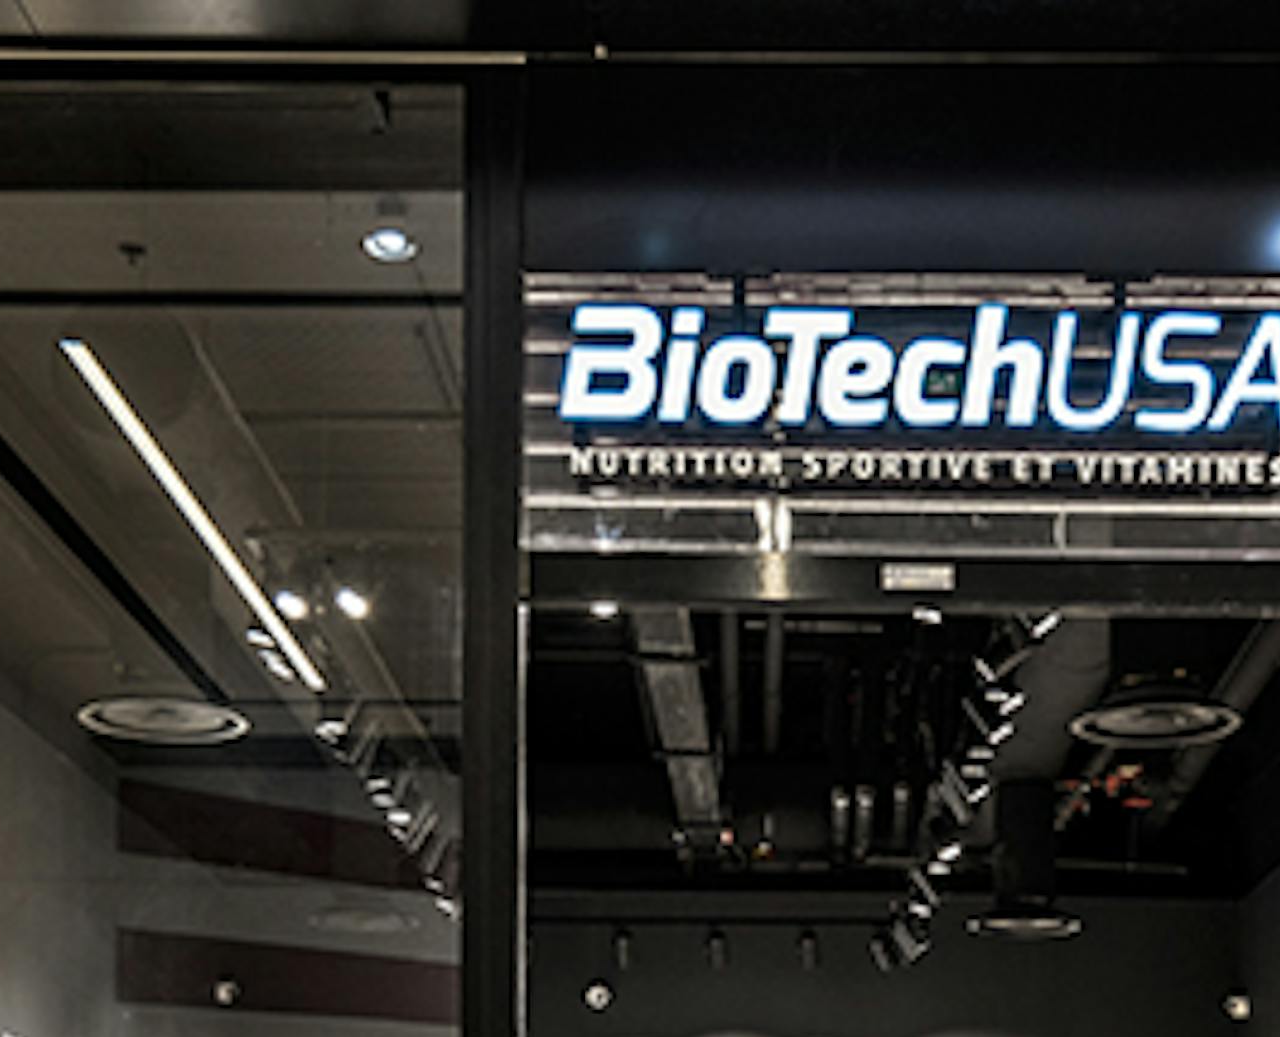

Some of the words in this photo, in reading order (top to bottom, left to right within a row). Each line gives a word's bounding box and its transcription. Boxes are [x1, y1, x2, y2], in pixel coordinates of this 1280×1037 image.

[569, 447, 784, 477] NUTRITION
[801, 450, 991, 481] SPORTIVE
[1011, 453, 1055, 482] ET
